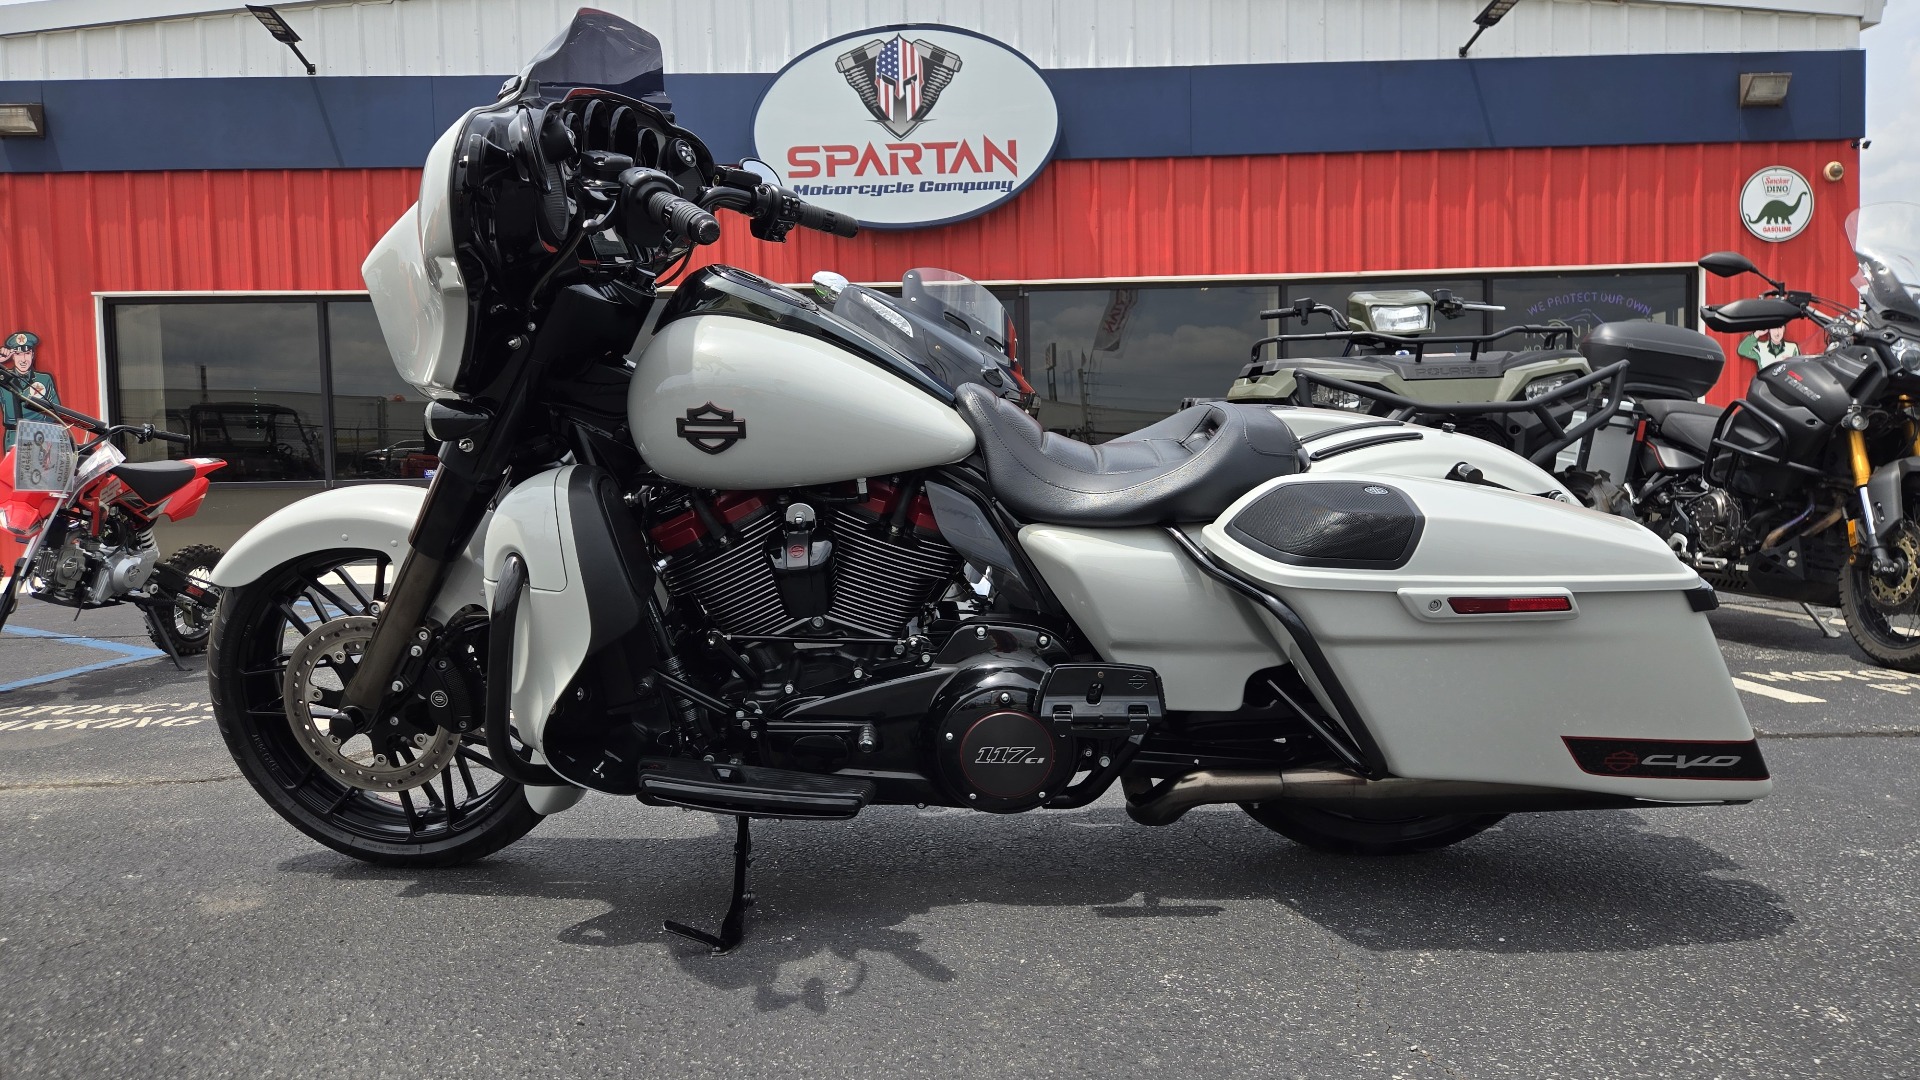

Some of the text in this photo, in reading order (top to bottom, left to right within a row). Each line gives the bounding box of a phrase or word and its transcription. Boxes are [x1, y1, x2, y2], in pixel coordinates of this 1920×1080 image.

[787, 134, 1018, 178] SPARTAN
[794, 180, 1014, 197] Motorcycle Company
[1766, 185, 1789, 193] DINO
[1527, 292, 1652, 316] WE PROTECT OUR OWN
[1414, 366, 1489, 376] POLARIS
[1641, 754, 1742, 769] CVO
